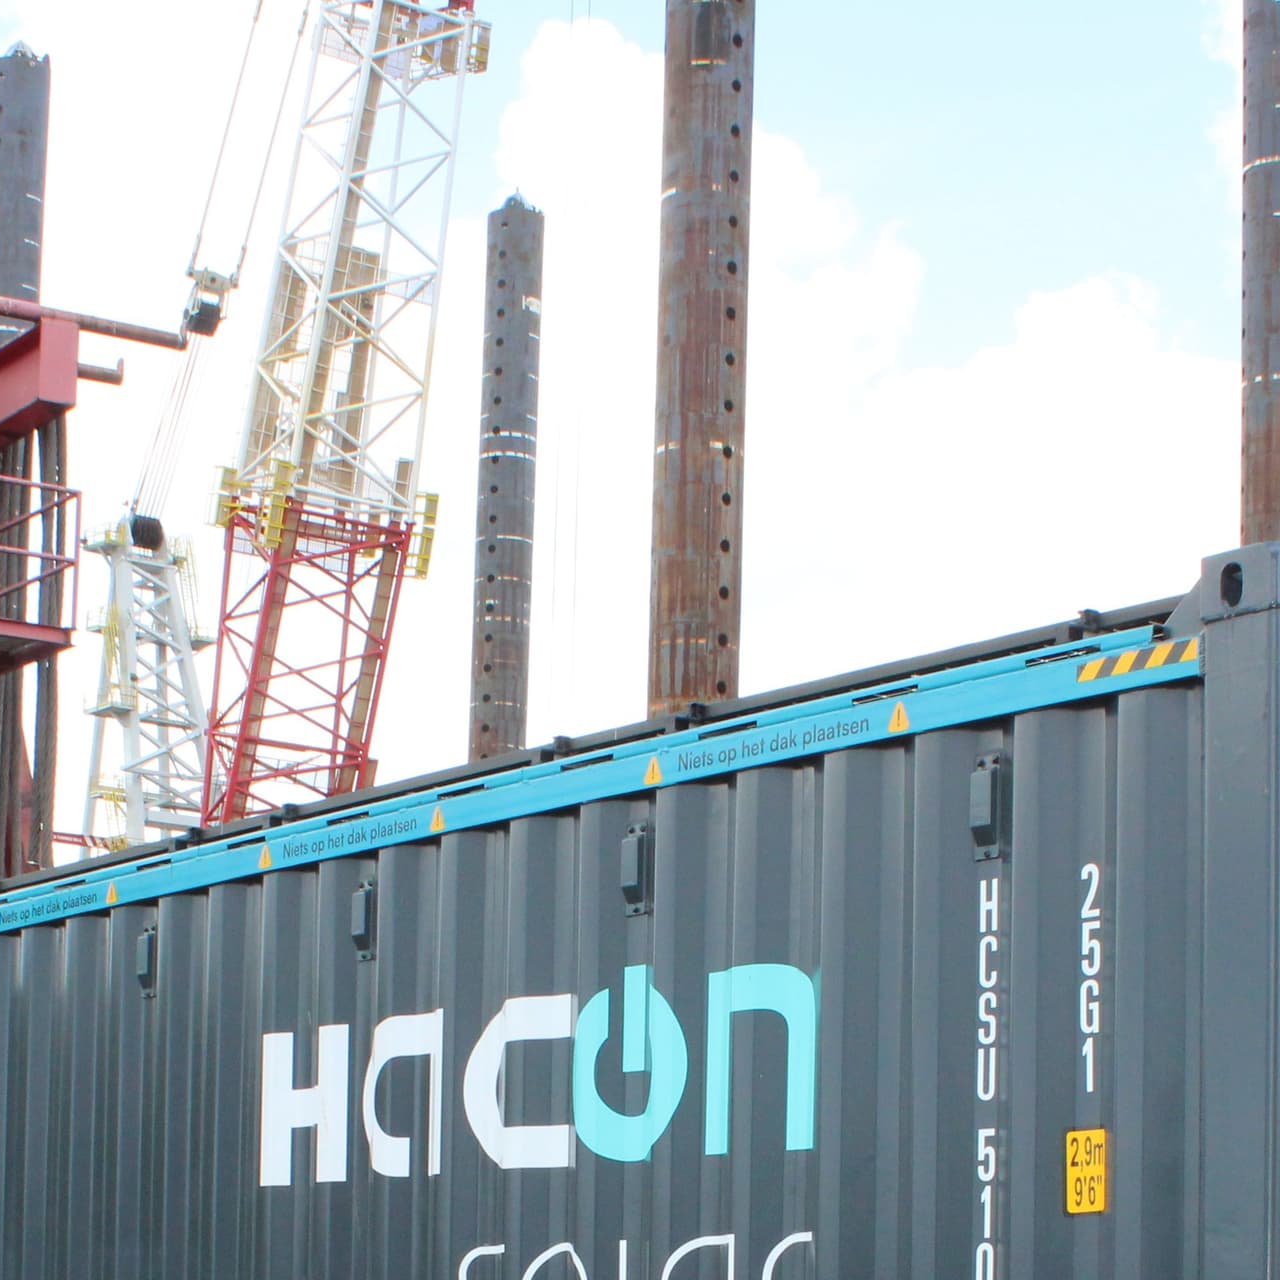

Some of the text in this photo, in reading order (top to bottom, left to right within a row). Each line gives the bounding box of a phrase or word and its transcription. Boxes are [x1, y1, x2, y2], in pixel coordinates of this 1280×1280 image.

[718, 749, 737, 764] op
[742, 738, 765, 758] het
[769, 729, 797, 752] dak
[802, 718, 870, 750] plaatsen
[311, 840, 325, 854] op
[327, 832, 344, 849] het
[347, 826, 367, 844] dak
[370, 818, 417, 842] plaatsen
[46, 898, 61, 914] dak
[976, 878, 999, 1102] HCSU
[1079, 862, 1101, 1094] 25G1
